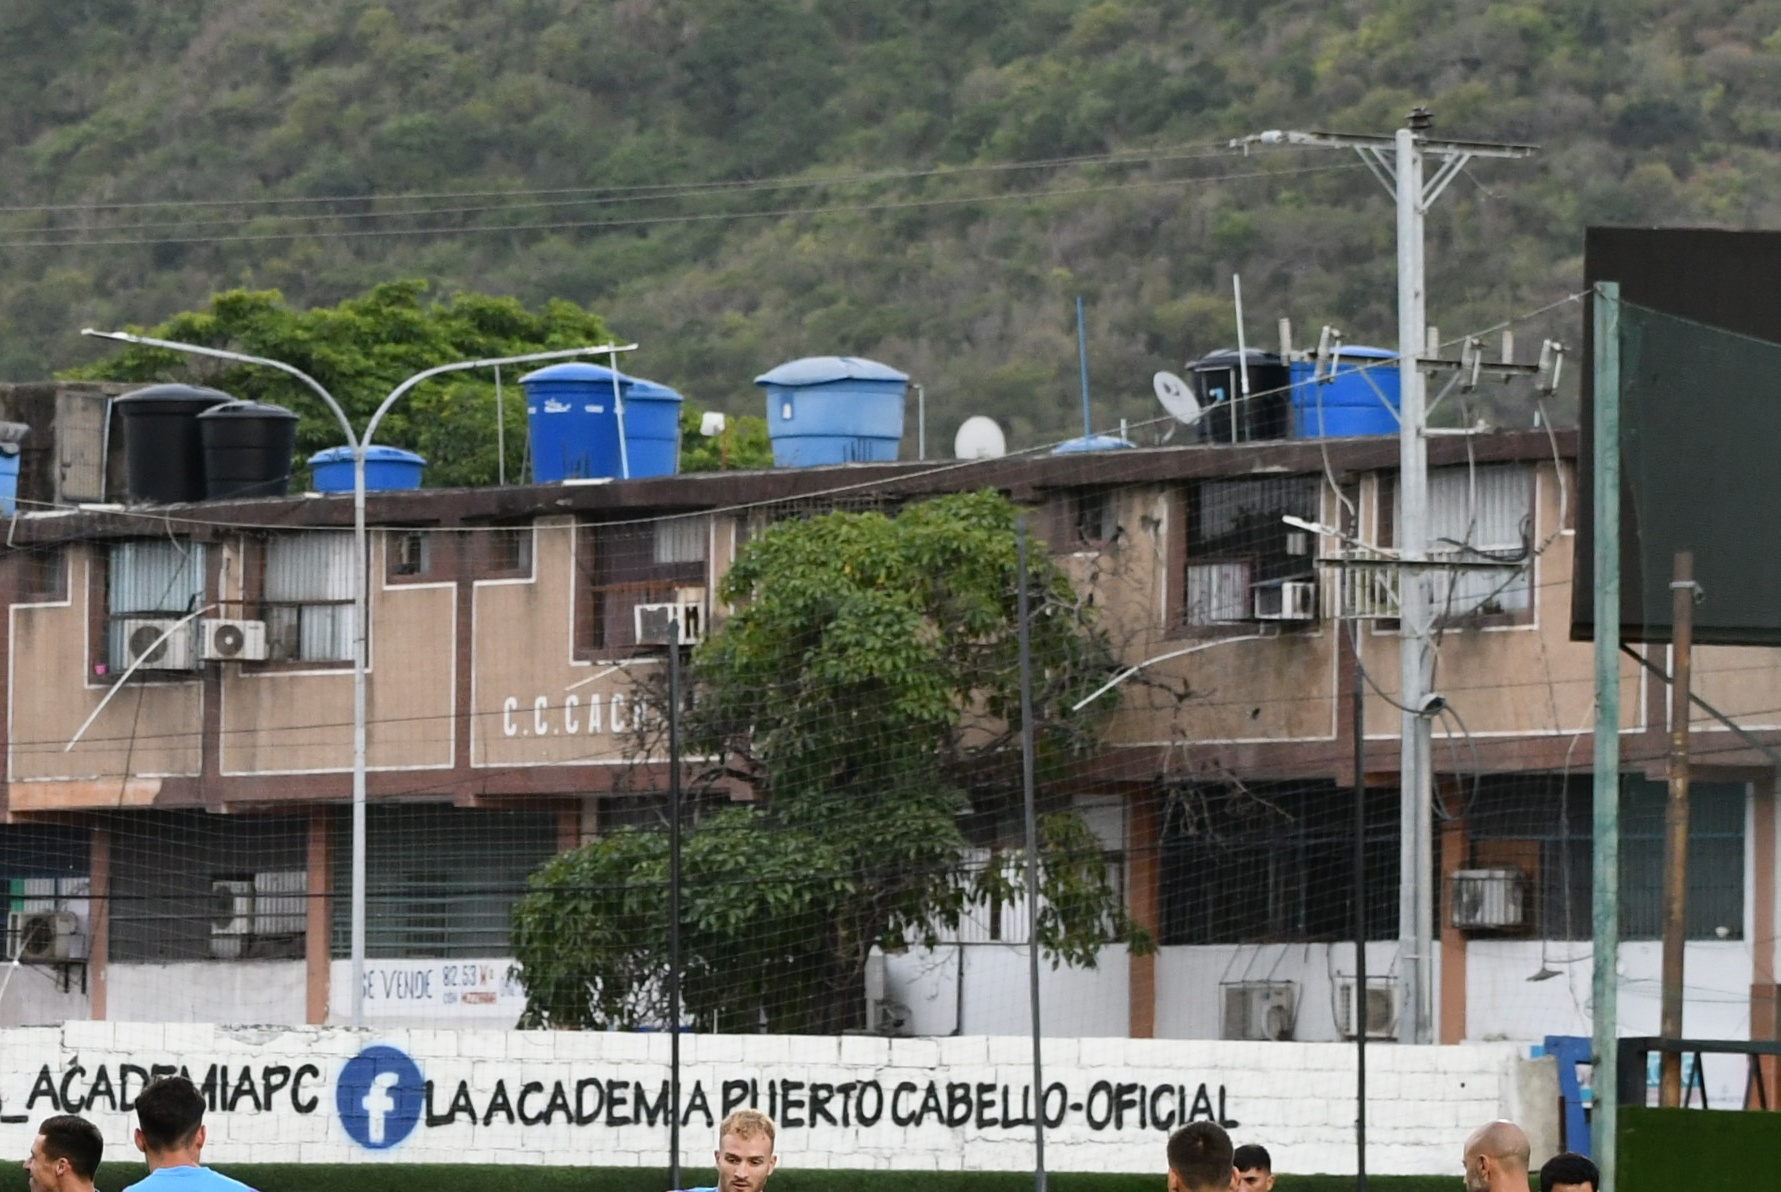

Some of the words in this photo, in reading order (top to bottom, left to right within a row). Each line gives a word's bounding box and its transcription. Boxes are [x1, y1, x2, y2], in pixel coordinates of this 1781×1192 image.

[380, 969, 433, 999] VENDE
[483, 1078, 714, 1127] ACADEMA
[722, 1077, 884, 1128] PUERTO
